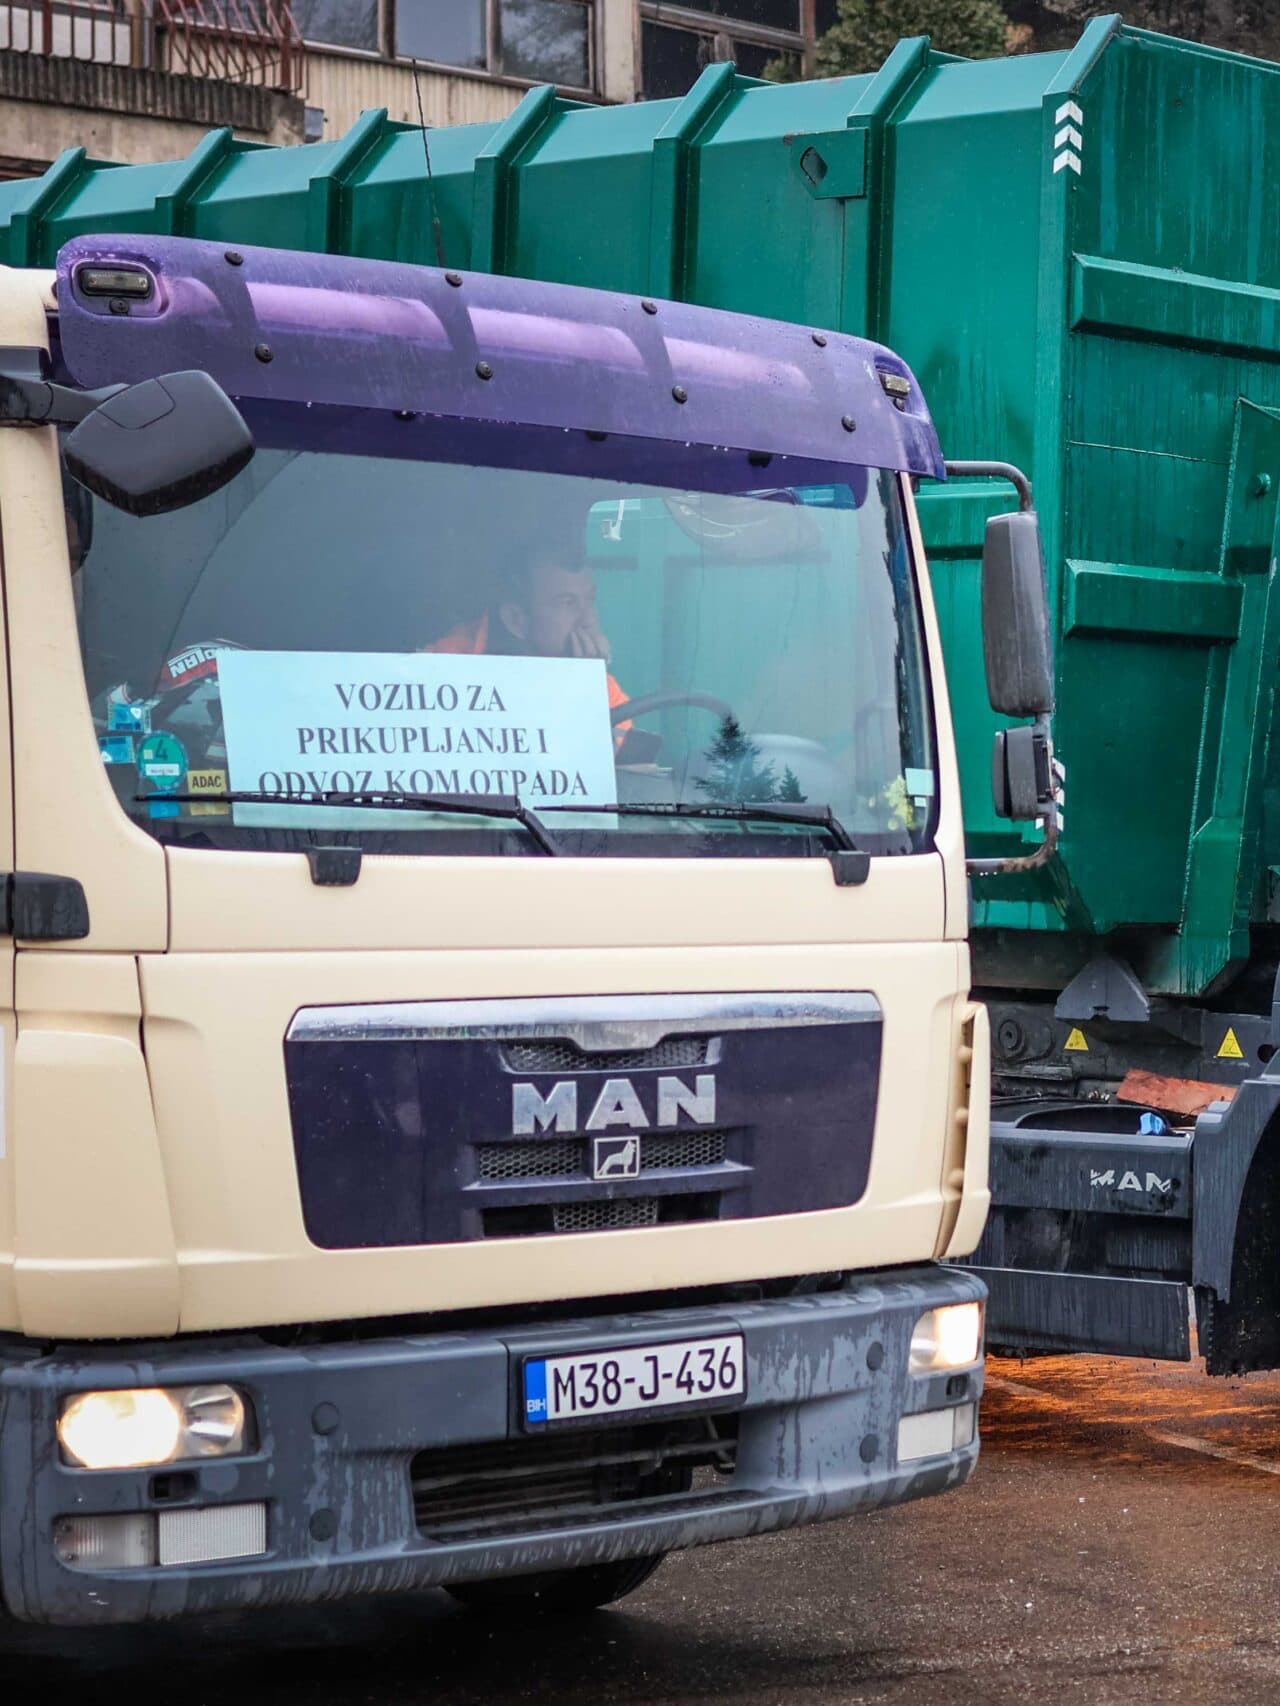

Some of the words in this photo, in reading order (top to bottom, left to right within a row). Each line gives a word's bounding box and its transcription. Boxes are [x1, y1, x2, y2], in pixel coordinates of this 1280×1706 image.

[334, 683, 459, 711] VOZILO
[467, 684, 507, 712] ZA
[155, 739, 169, 761] 4
[296, 726, 530, 755] PRIKUPLJANJE
[537, 728, 550, 754] I
[192, 775, 222, 788] ADAC
[258, 770, 371, 797] ODVOZ
[512, 1074, 716, 1135] MAN
[1090, 1169, 1171, 1192] MAN
[526, 1398, 546, 1413] BIH
[553, 1346, 737, 1413] M38-J-436
